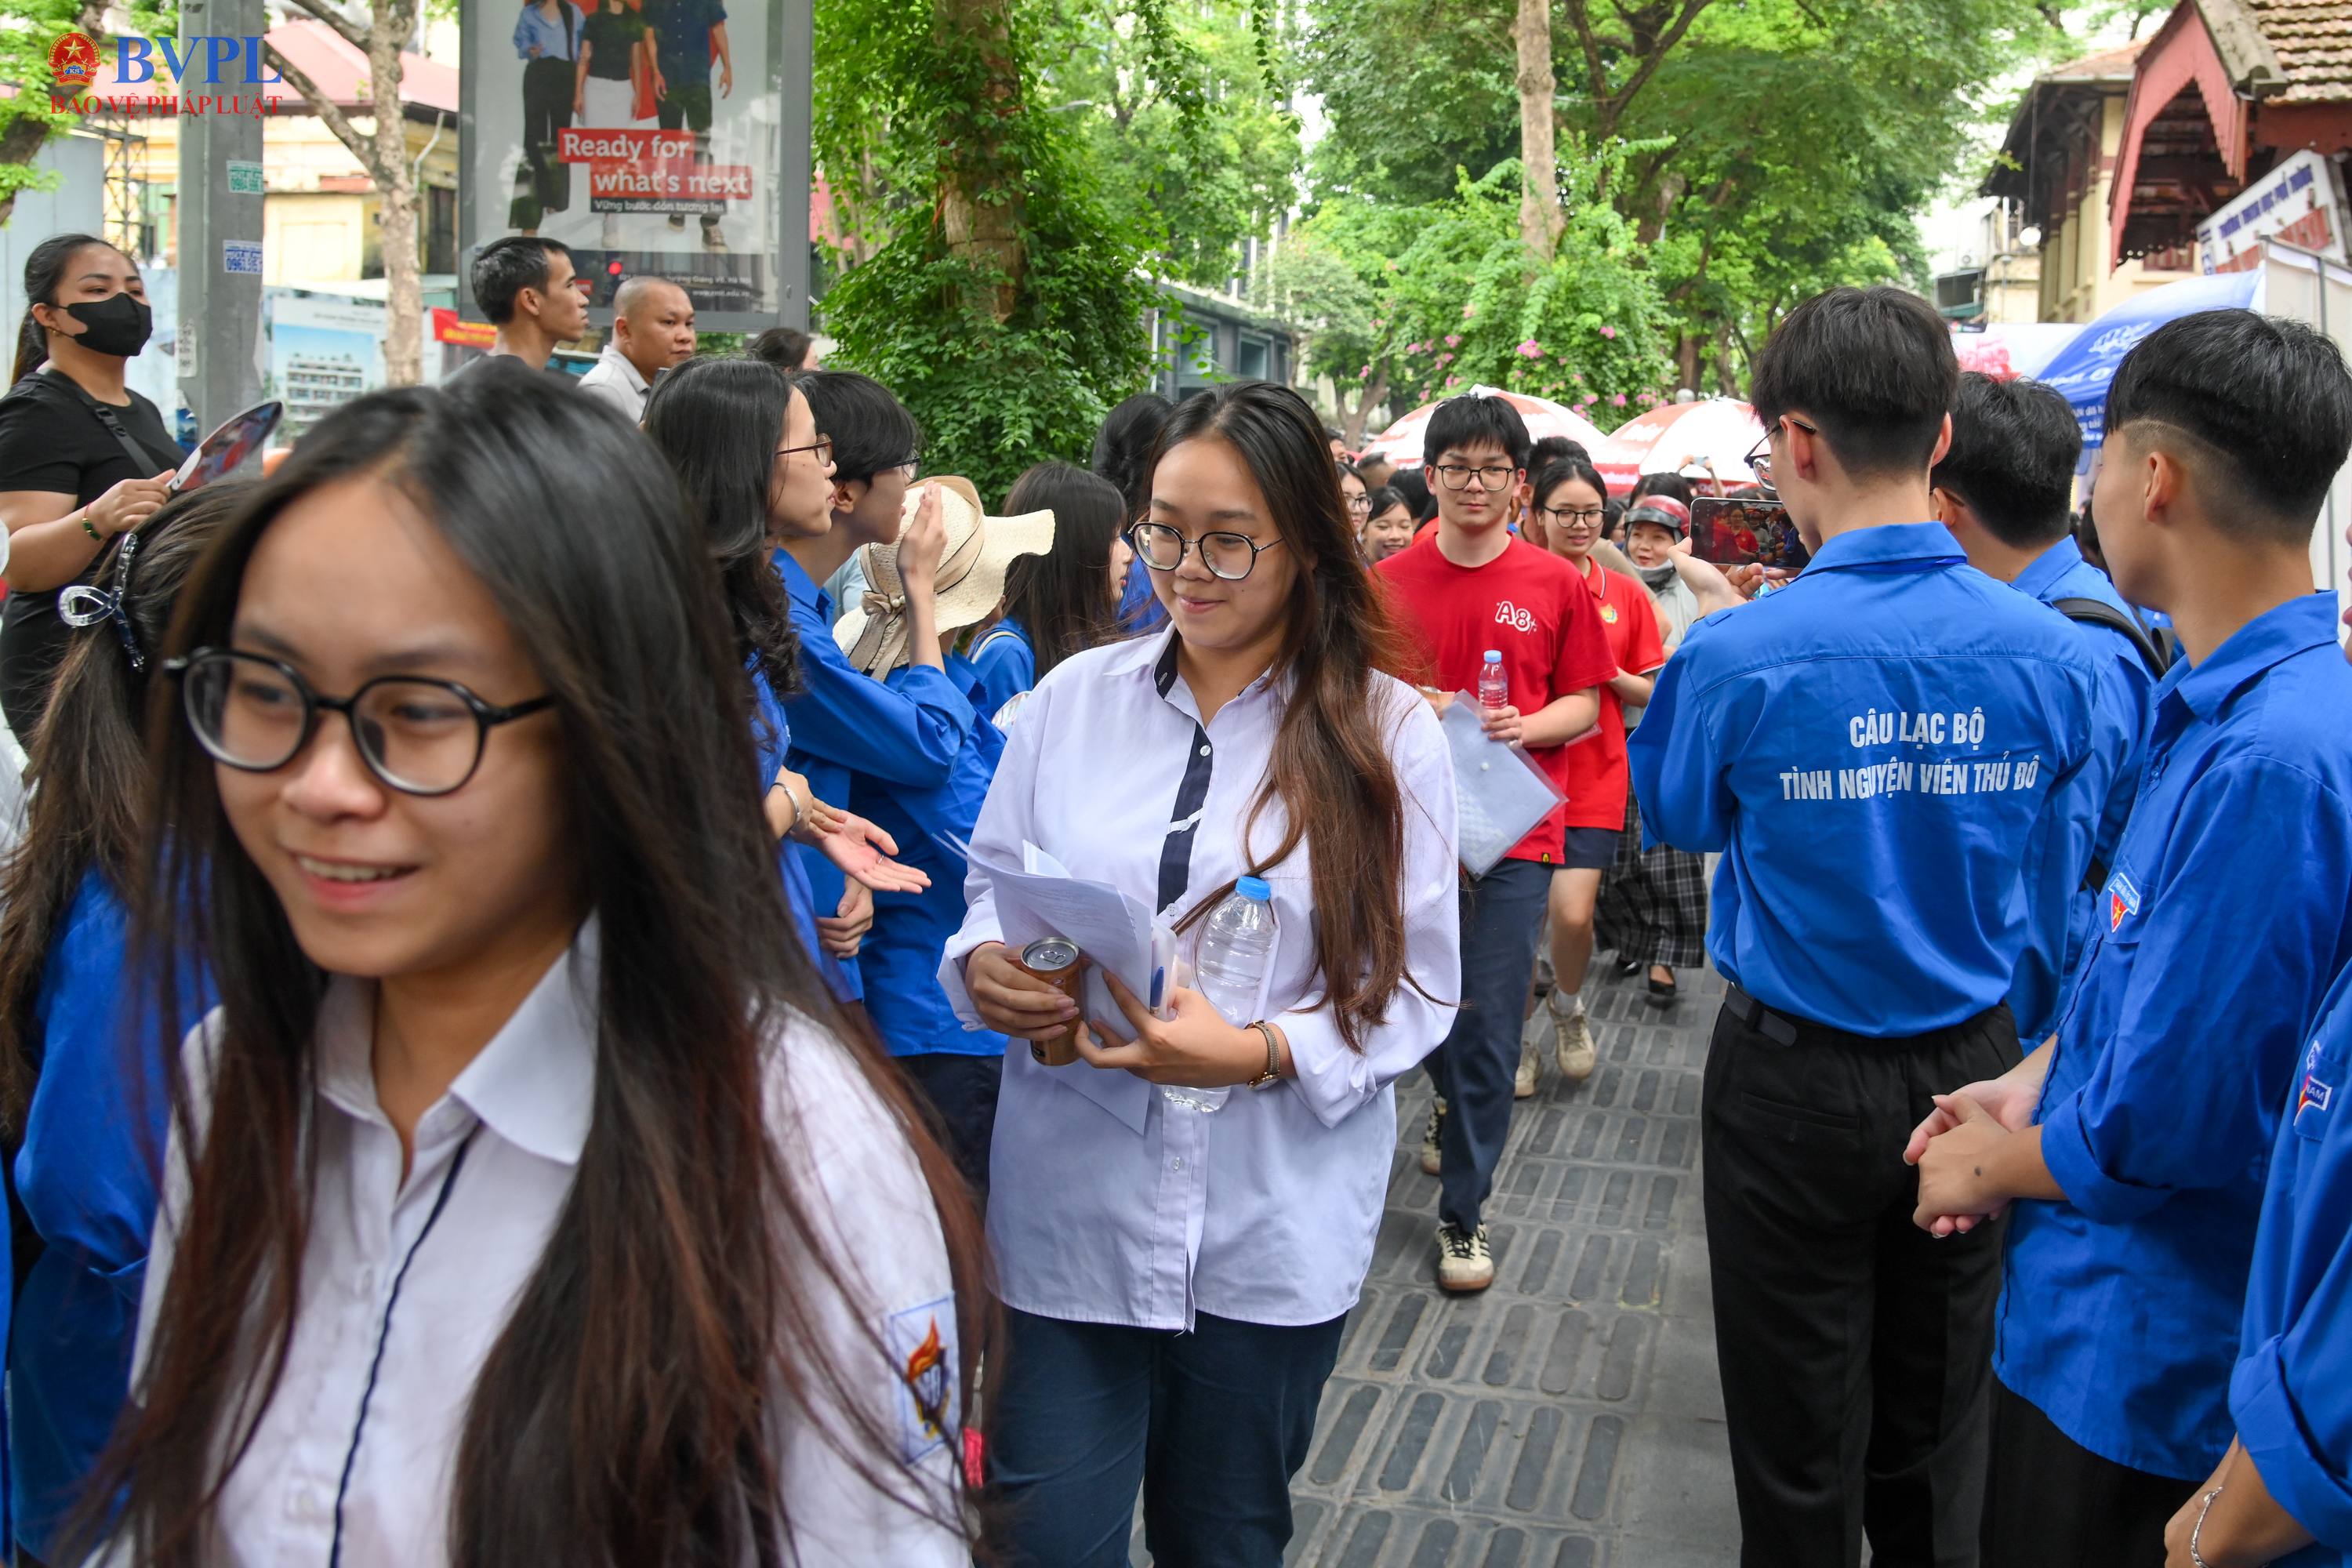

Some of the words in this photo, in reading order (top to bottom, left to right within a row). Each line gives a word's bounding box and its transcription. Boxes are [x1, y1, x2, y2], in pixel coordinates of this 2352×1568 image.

[564, 133, 643, 162] Ready
[652, 135, 690, 158] for
[595, 169, 680, 192] what's
[688, 174, 749, 194] next
[1494, 601, 1531, 632] A8
[1849, 708, 1893, 748] CÂU
[1899, 711, 1945, 750] LẠC
[1952, 706, 1985, 750] BỘ
[1780, 766, 1832, 800] TÌNH
[1838, 756, 1914, 798] NGUYỆN
[1920, 758, 1968, 795] VIÊN
[1973, 750, 2009, 793] THỦ
[2013, 755, 2040, 790] ĐÔ
